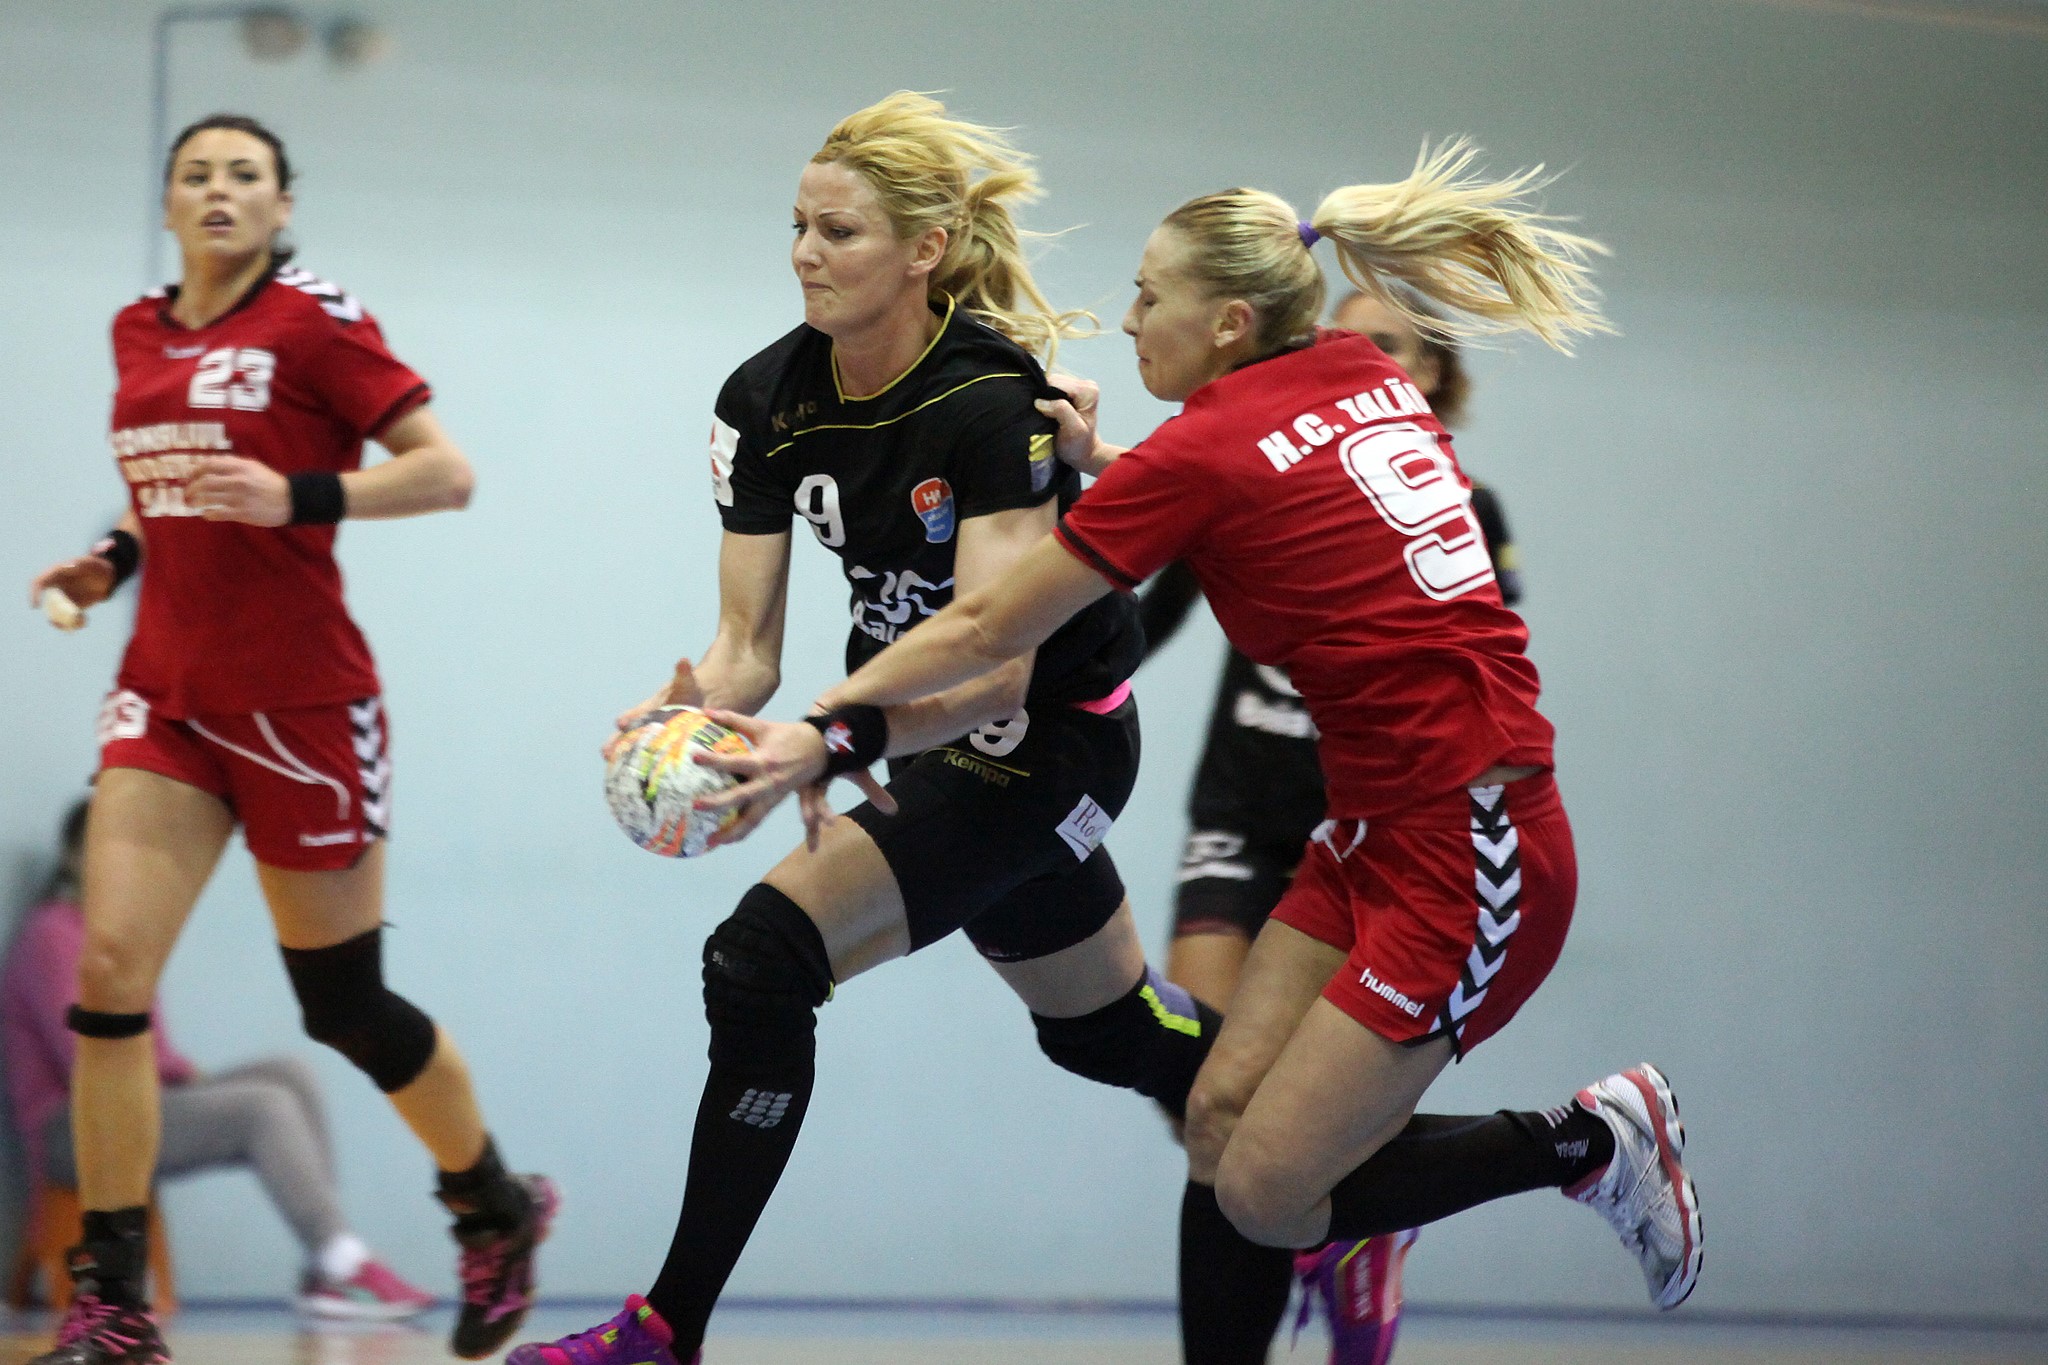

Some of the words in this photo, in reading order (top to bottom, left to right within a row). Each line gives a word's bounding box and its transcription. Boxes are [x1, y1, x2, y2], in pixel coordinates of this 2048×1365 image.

[188, 347, 276, 411] 23
[1257, 413, 1345, 473] H.C.
[794, 474, 846, 547] 9
[1338, 421, 1496, 601] 9
[943, 750, 1010, 788] Kempa
[1359, 967, 1425, 1018] hummel
